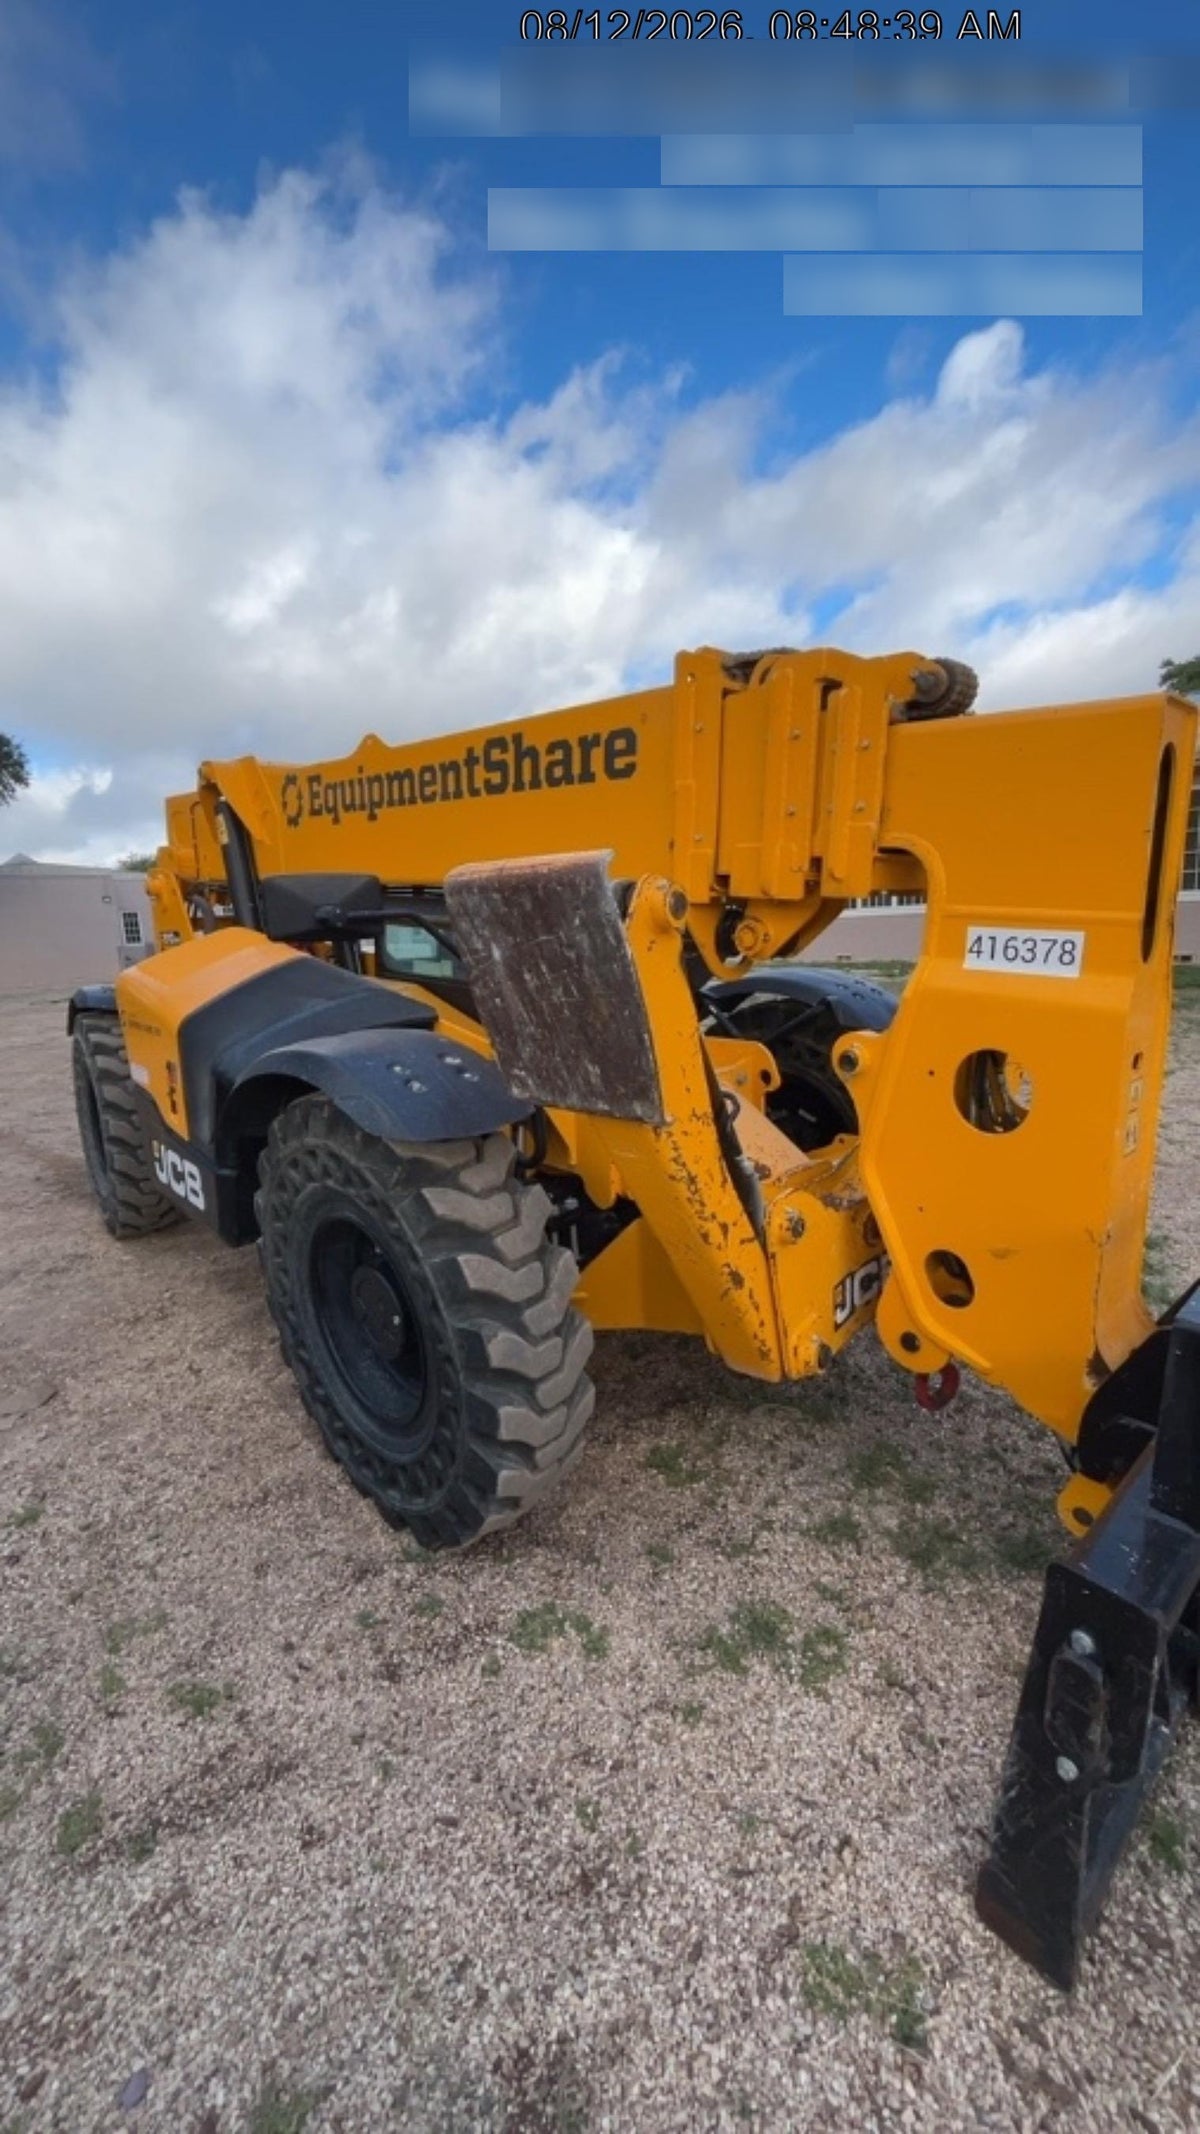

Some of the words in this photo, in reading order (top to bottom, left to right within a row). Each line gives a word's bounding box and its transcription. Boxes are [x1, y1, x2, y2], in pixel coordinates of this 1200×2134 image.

[307, 726, 638, 826] EquipmentShare
[967, 935, 1077, 966] 416378
[153, 1140, 205, 1211] JCB
